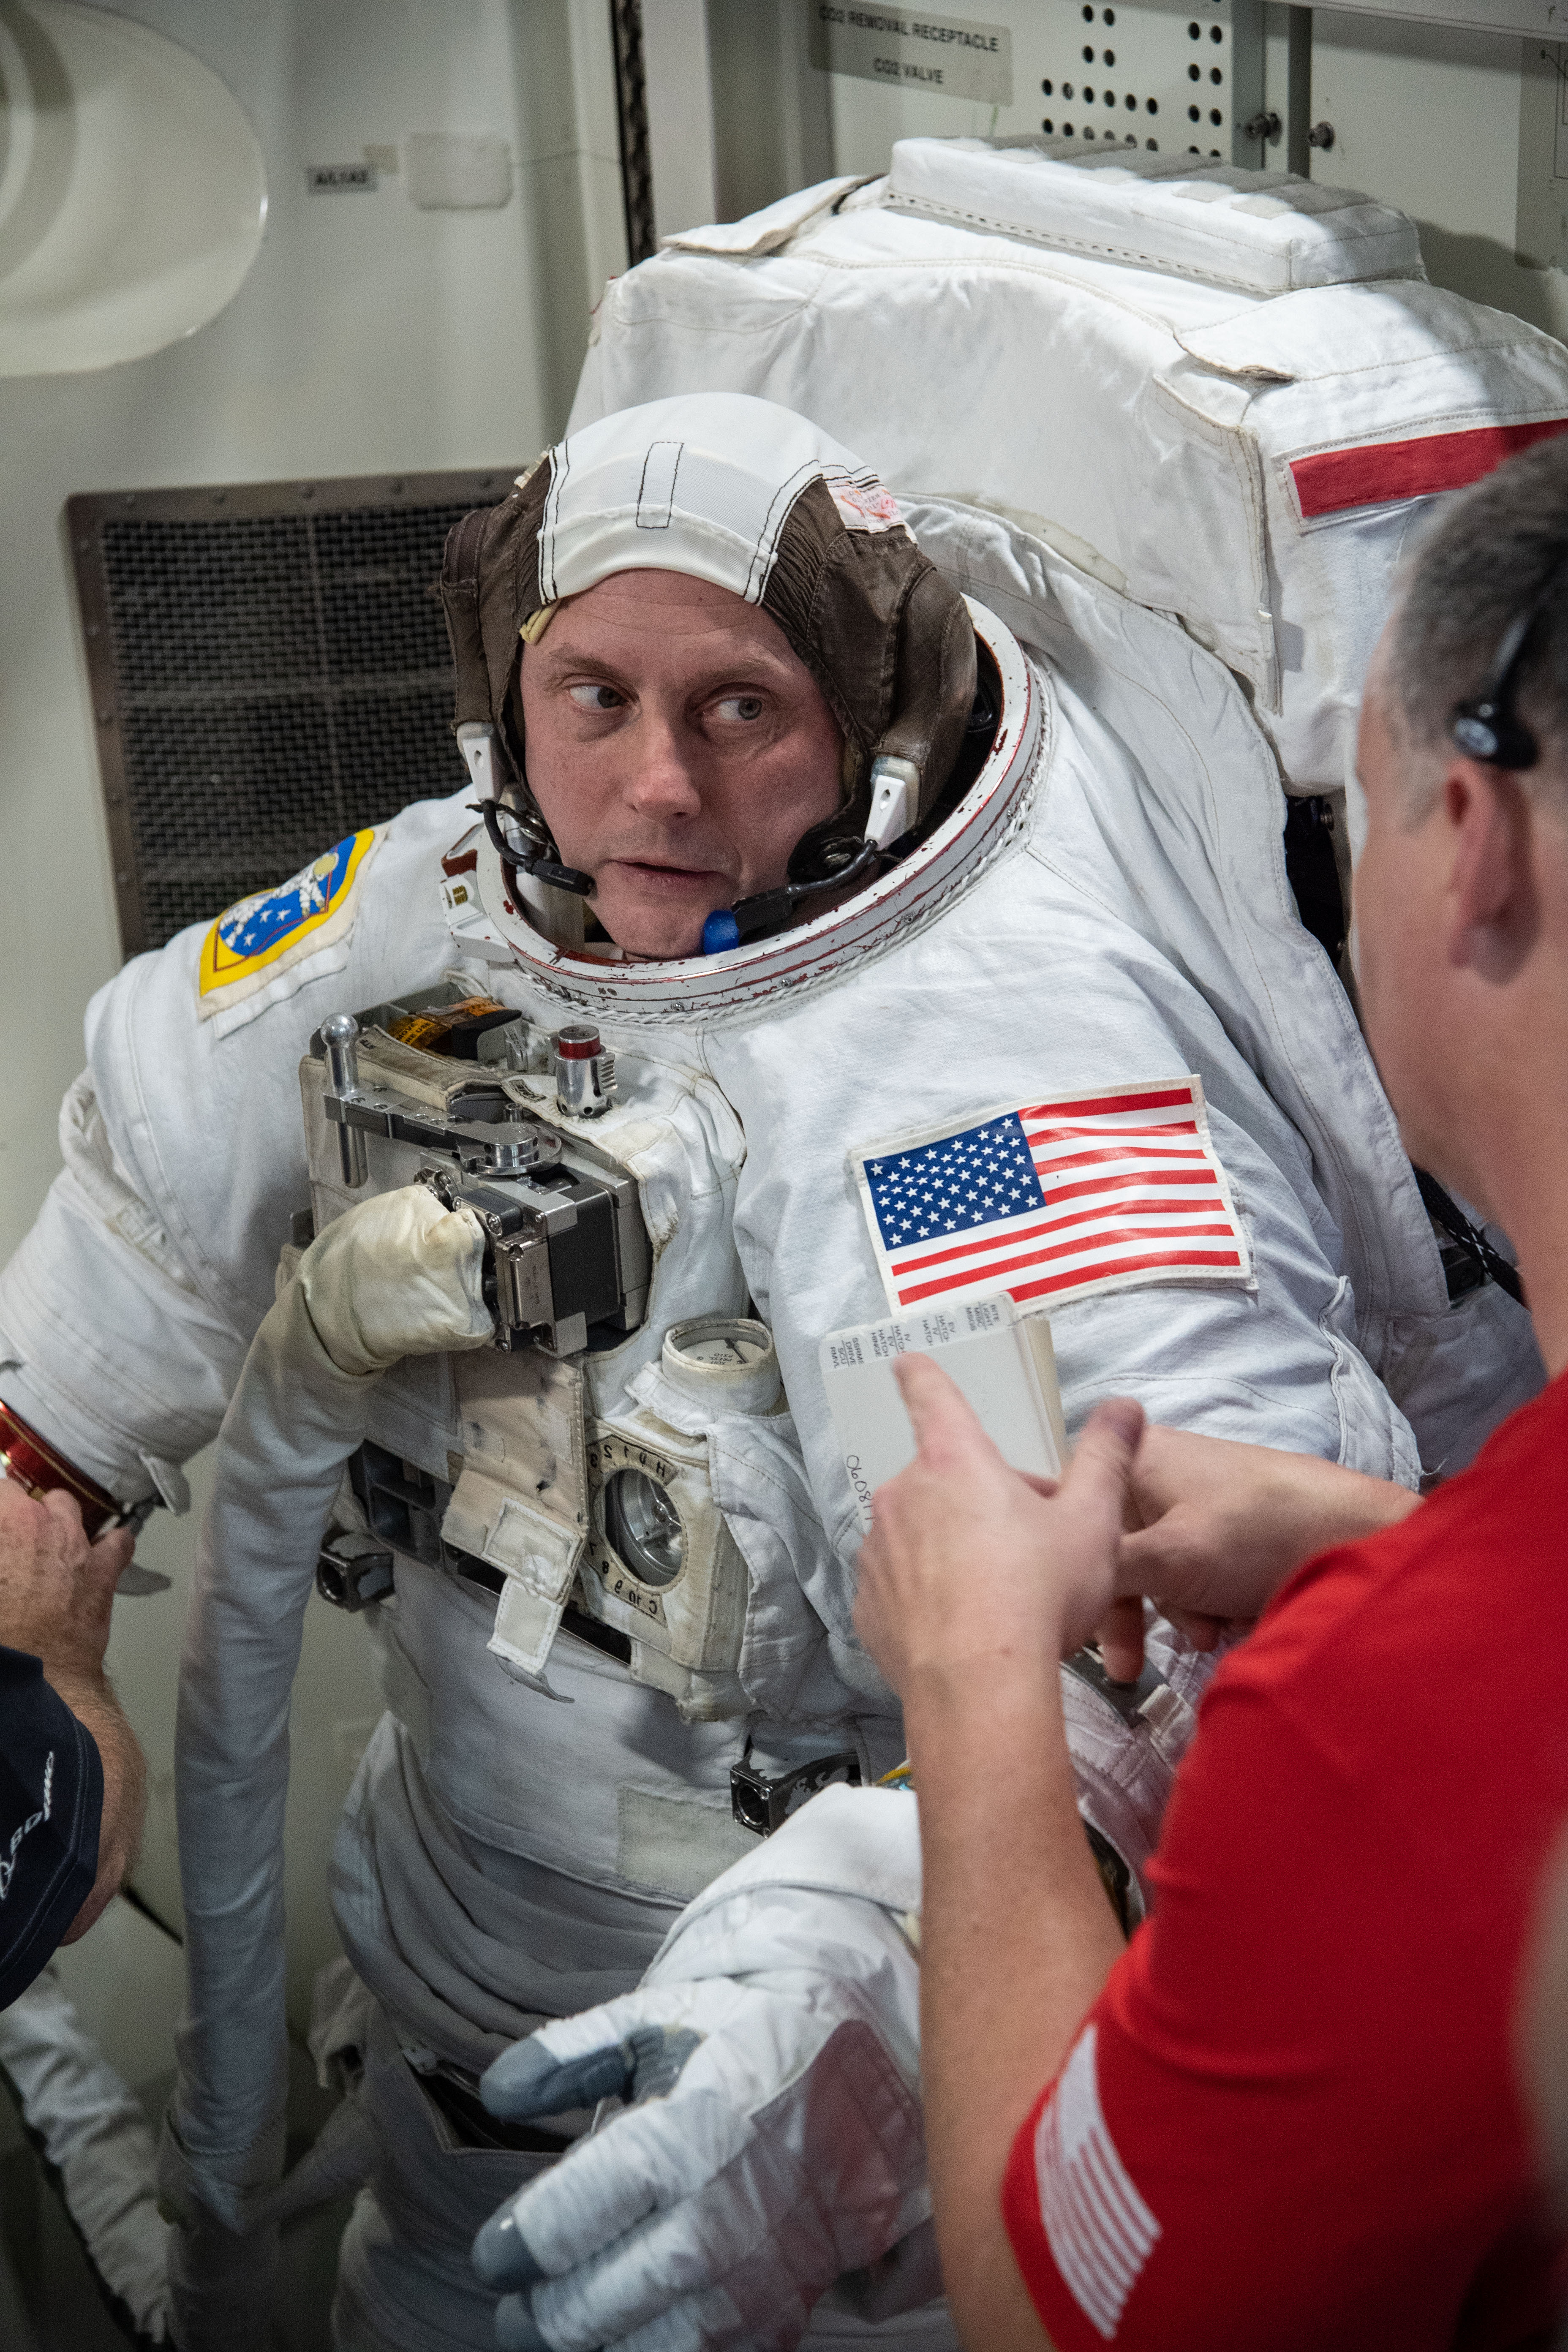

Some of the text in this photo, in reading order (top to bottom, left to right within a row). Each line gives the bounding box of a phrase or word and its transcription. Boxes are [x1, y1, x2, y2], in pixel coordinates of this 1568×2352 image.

[847, 11, 909, 35] REMOVAL
[912, 22, 999, 52] RECEPTACLE
[902, 63, 944, 84] VALVE
[894, 1326, 906, 1353] HATCH
[923, 1319, 933, 1346] HATCH
[939, 1315, 950, 1342] HATCH
[948, 1322, 956, 1333] EV
[845, 1342, 856, 1365] DRIVE
[852, 1337, 863, 1364] SSRMS
[871, 1332, 882, 1357] HINGE
[878, 1329, 889, 1357] HATCH
[887, 1336, 896, 1347] EV
[830, 1347, 839, 1369] RMVL
[838, 1348, 847, 1364] SCU
